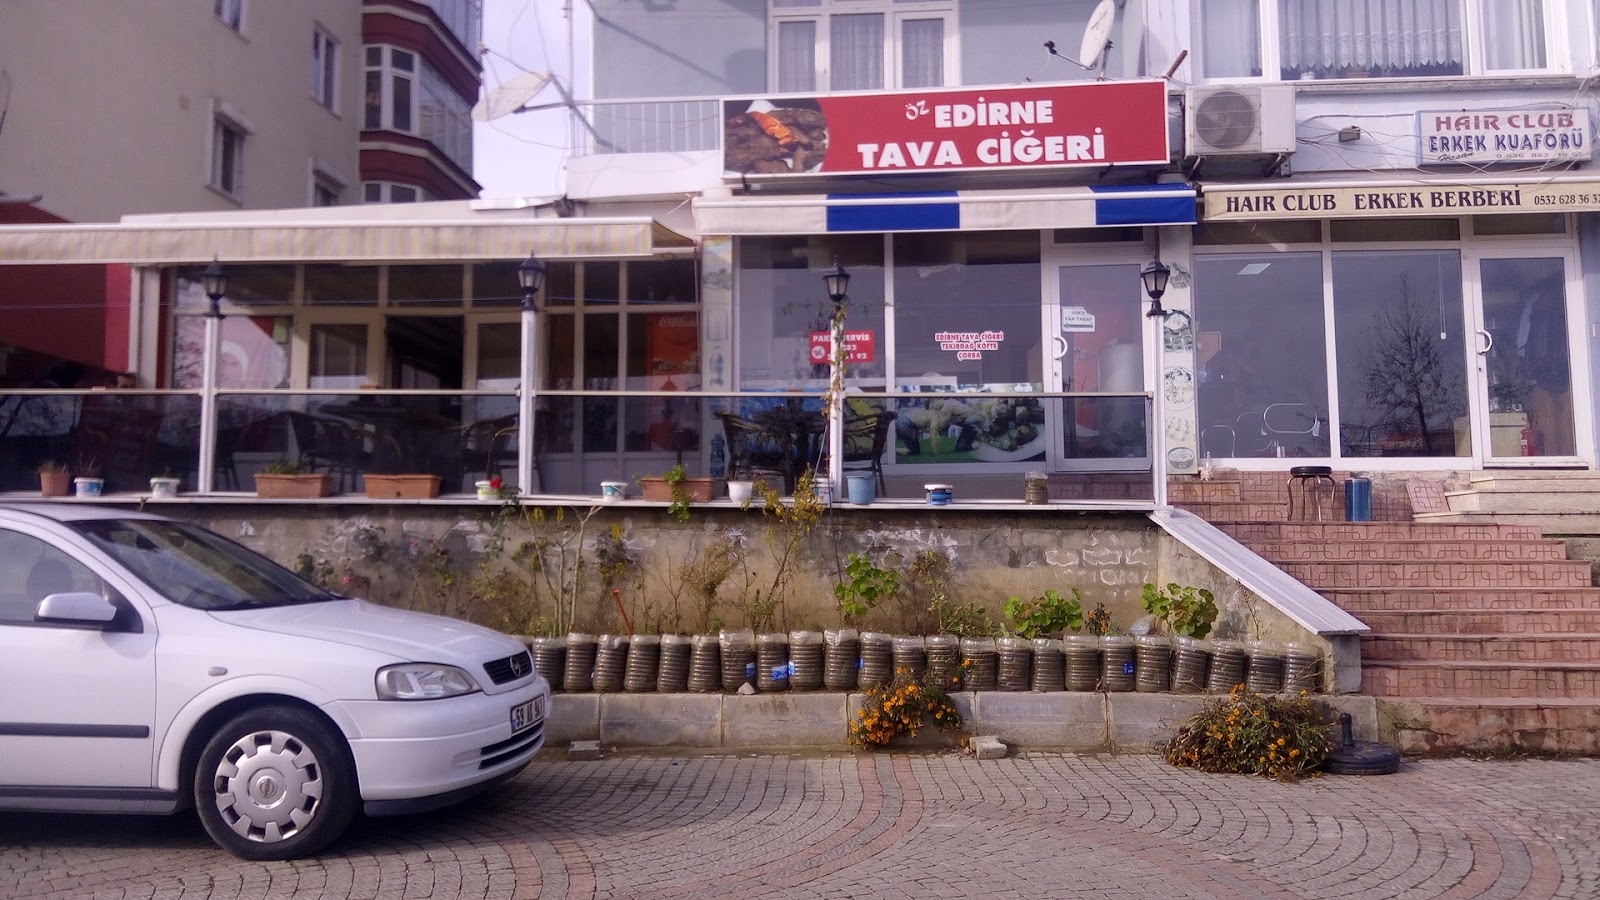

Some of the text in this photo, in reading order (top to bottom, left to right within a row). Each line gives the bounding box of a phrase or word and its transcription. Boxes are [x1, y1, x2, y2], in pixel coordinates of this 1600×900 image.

[934, 96, 1054, 128] EDİRNE
[1435, 113, 1574, 132] HAIR CLUB
[857, 127, 1105, 168] TAVA CİĞERİ
[1428, 128, 1584, 153] ERKEK KUAFÖRÜ
[1226, 196, 1276, 213] HAIR
[1282, 194, 1337, 212] CLUB
[1354, 191, 1425, 210] ERKEK
[1430, 184, 1522, 209] BERBERİ
[1534, 195, 1556, 206] 0532
[1559, 194, 1576, 205] 628
[1578, 194, 1590, 204] 36
[842, 333, 870, 342] ERVİS
[935, 331, 960, 342] EDİRNE
[961, 333, 980, 342] TAVA
